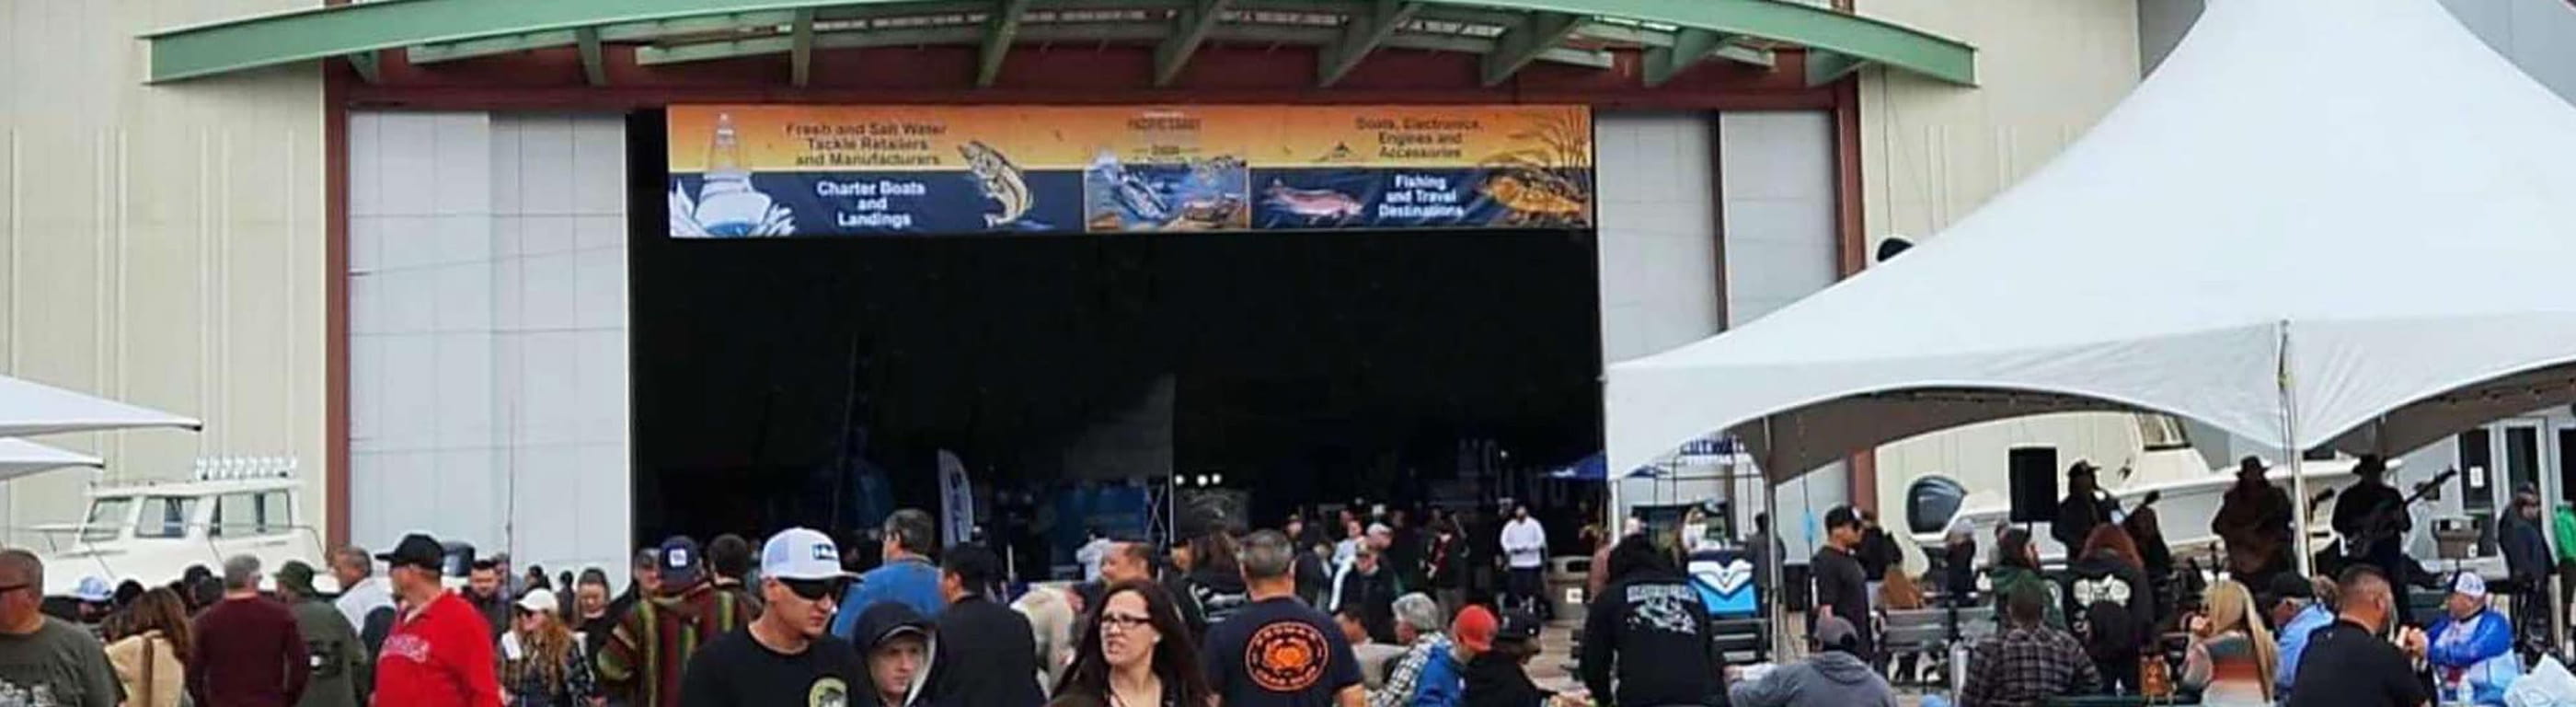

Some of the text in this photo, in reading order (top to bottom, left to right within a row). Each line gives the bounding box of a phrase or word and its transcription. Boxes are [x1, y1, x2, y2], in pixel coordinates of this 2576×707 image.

[785, 123, 833, 135] Fresh
[836, 123, 867, 135] and
[901, 123, 947, 135] Water
[808, 137, 929, 151] Tackle Retailers
[1378, 132, 1463, 145] Engines and
[1378, 146, 1462, 157] Accessories
[795, 153, 941, 166] and Manufacturers
[817, 180, 926, 196] Charter Boats
[1395, 173, 1446, 191] Fishing
[1386, 189, 1456, 203] and Travel
[857, 196, 888, 211] and
[1378, 203, 1465, 218] Destinations
[837, 211, 912, 229] Landings
